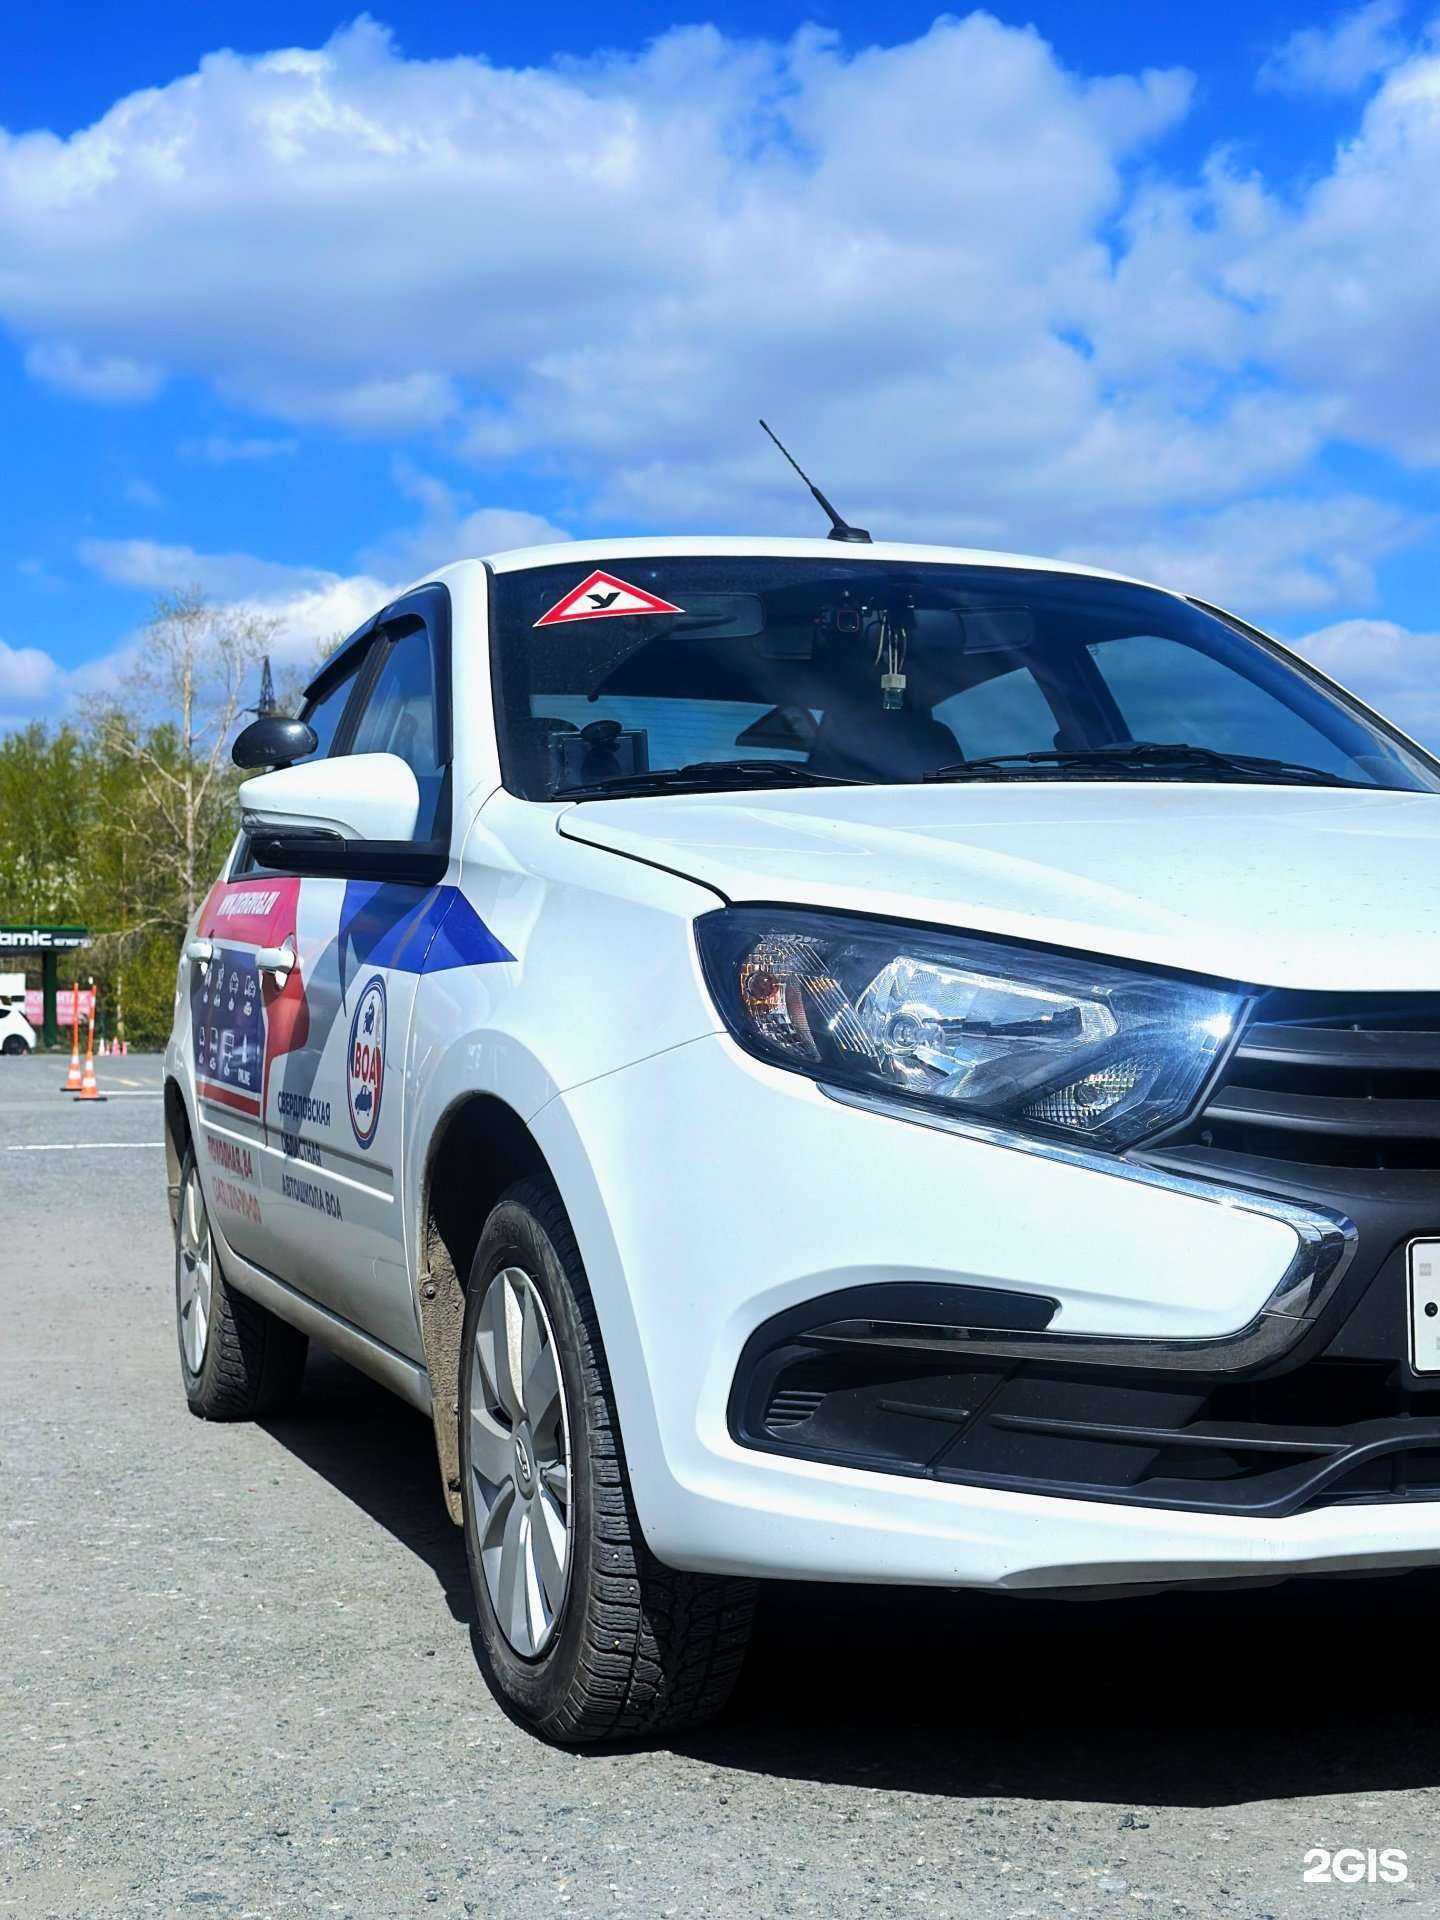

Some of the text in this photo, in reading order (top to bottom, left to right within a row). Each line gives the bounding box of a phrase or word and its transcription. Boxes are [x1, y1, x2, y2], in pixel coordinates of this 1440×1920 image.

[587, 592, 621, 610] У
[354, 1042, 377, 1086] ВОА
[278, 1091, 331, 1128] СВЕРДЛОВСКАЯ
[282, 1173, 325, 1211] АВТОШКОЛА
[326, 1192, 344, 1222] ВОА
